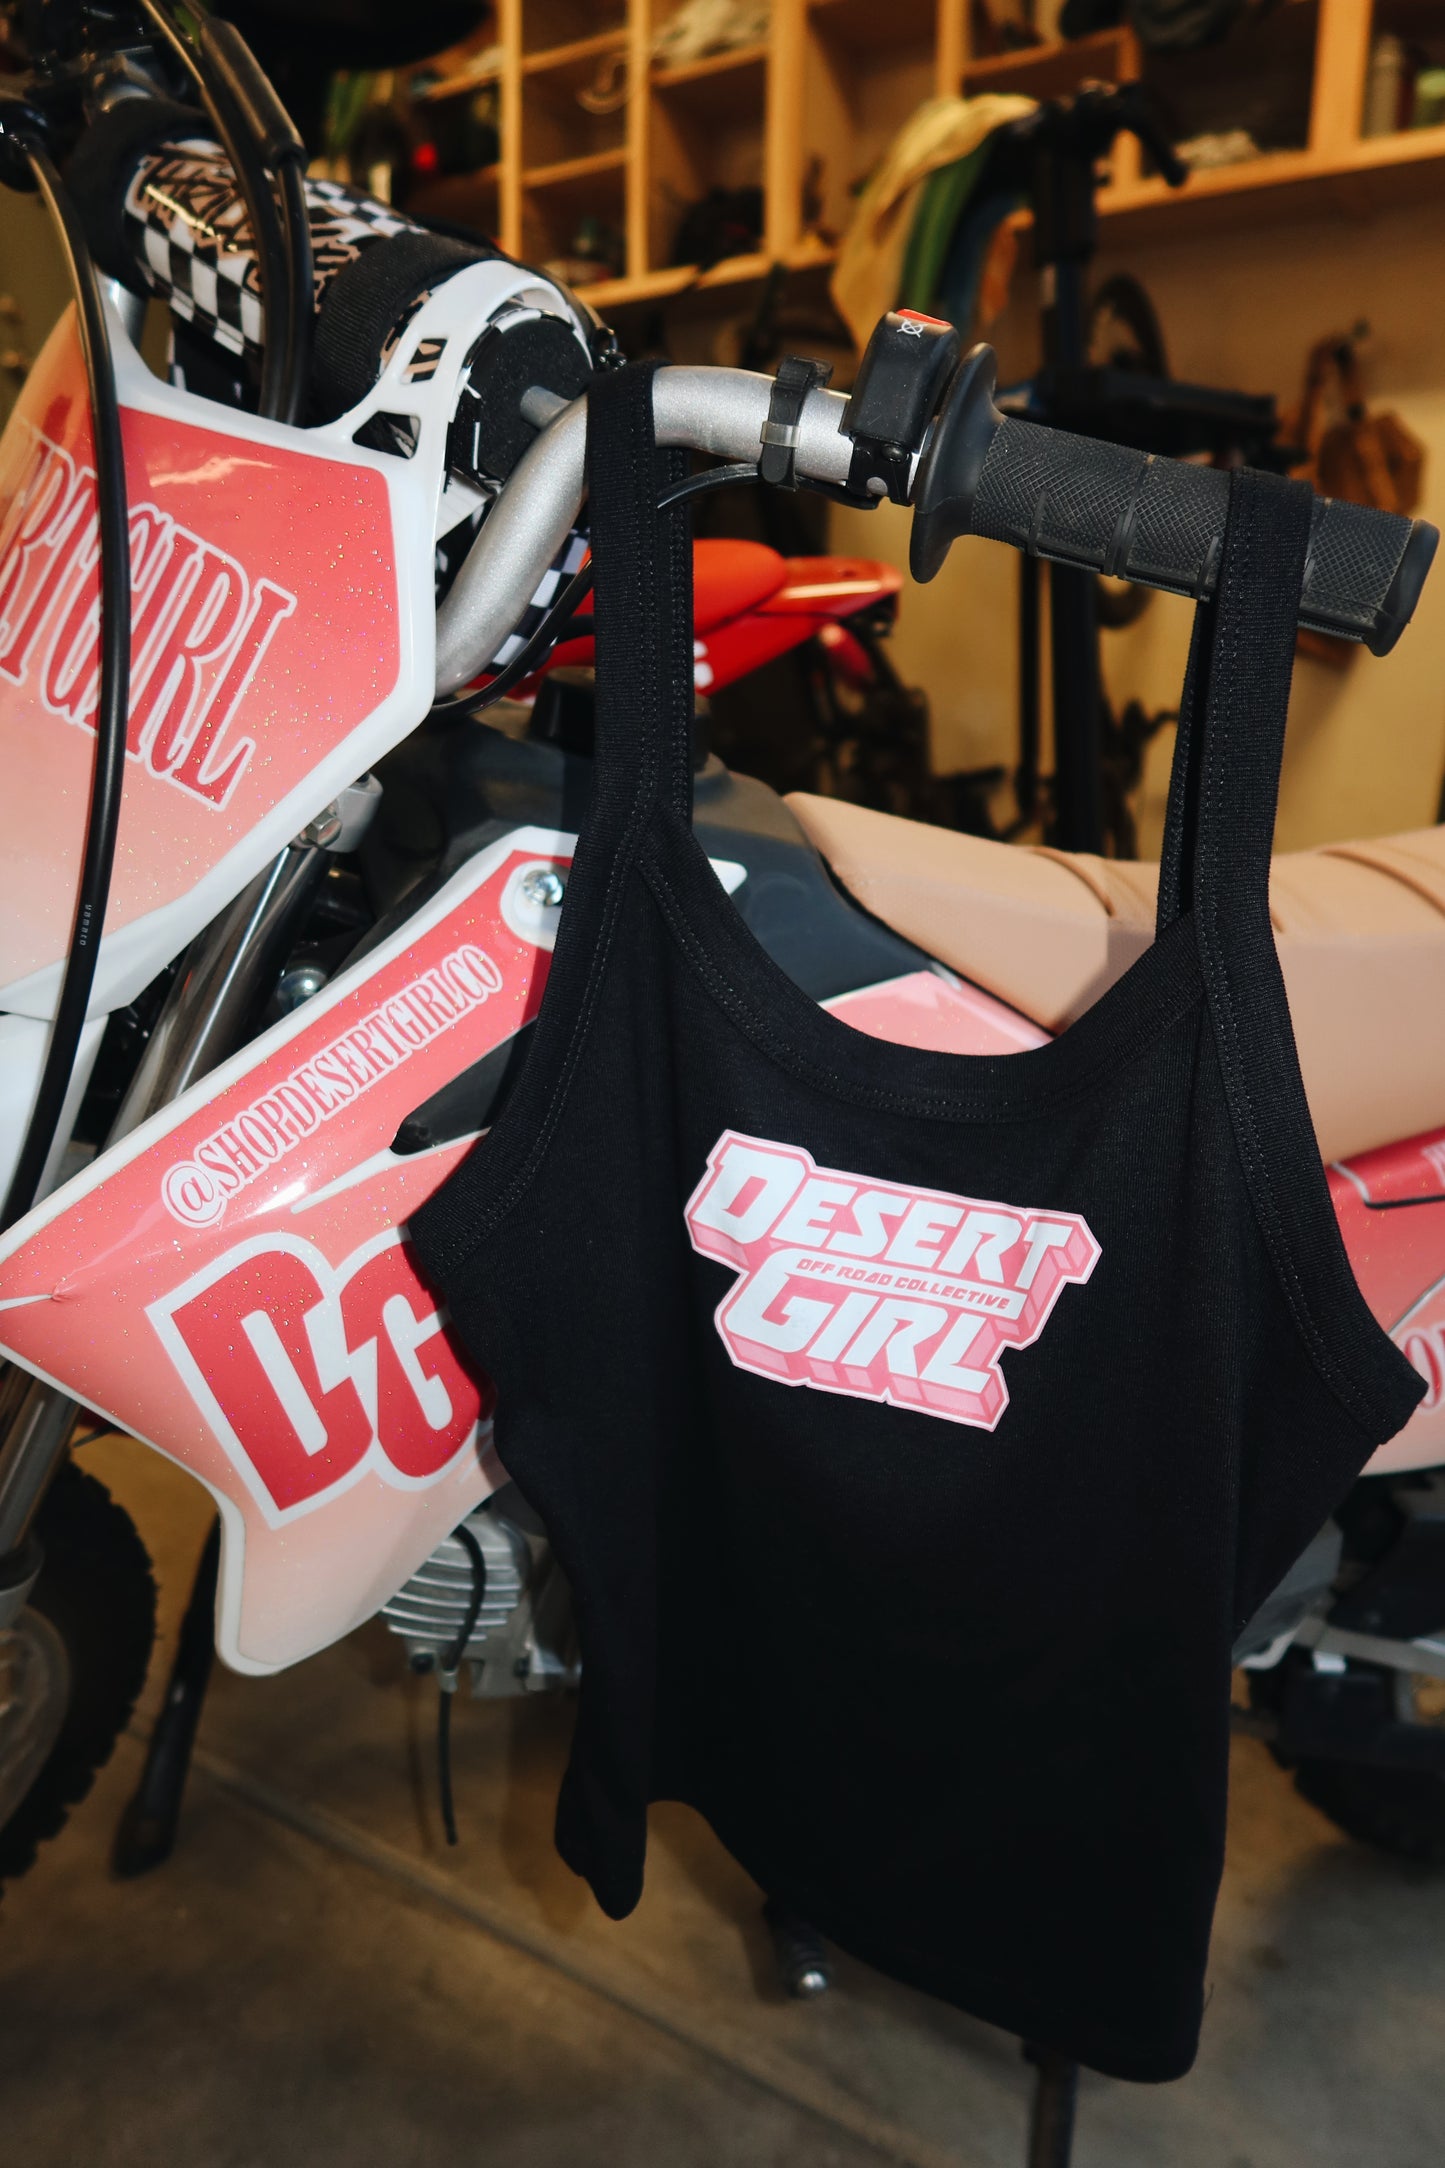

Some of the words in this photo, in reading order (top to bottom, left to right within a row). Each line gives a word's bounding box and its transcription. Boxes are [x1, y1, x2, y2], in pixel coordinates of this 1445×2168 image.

[161, 944, 503, 1228] @SHOPDESERTGIRLCO
[690, 1140, 1077, 1292] DESERT
[796, 1257, 835, 1275] OFF
[836, 1267, 893, 1287] ROAD
[894, 1276, 1010, 1310] COLLECTIVE
[723, 1248, 1012, 1396] GIRL
